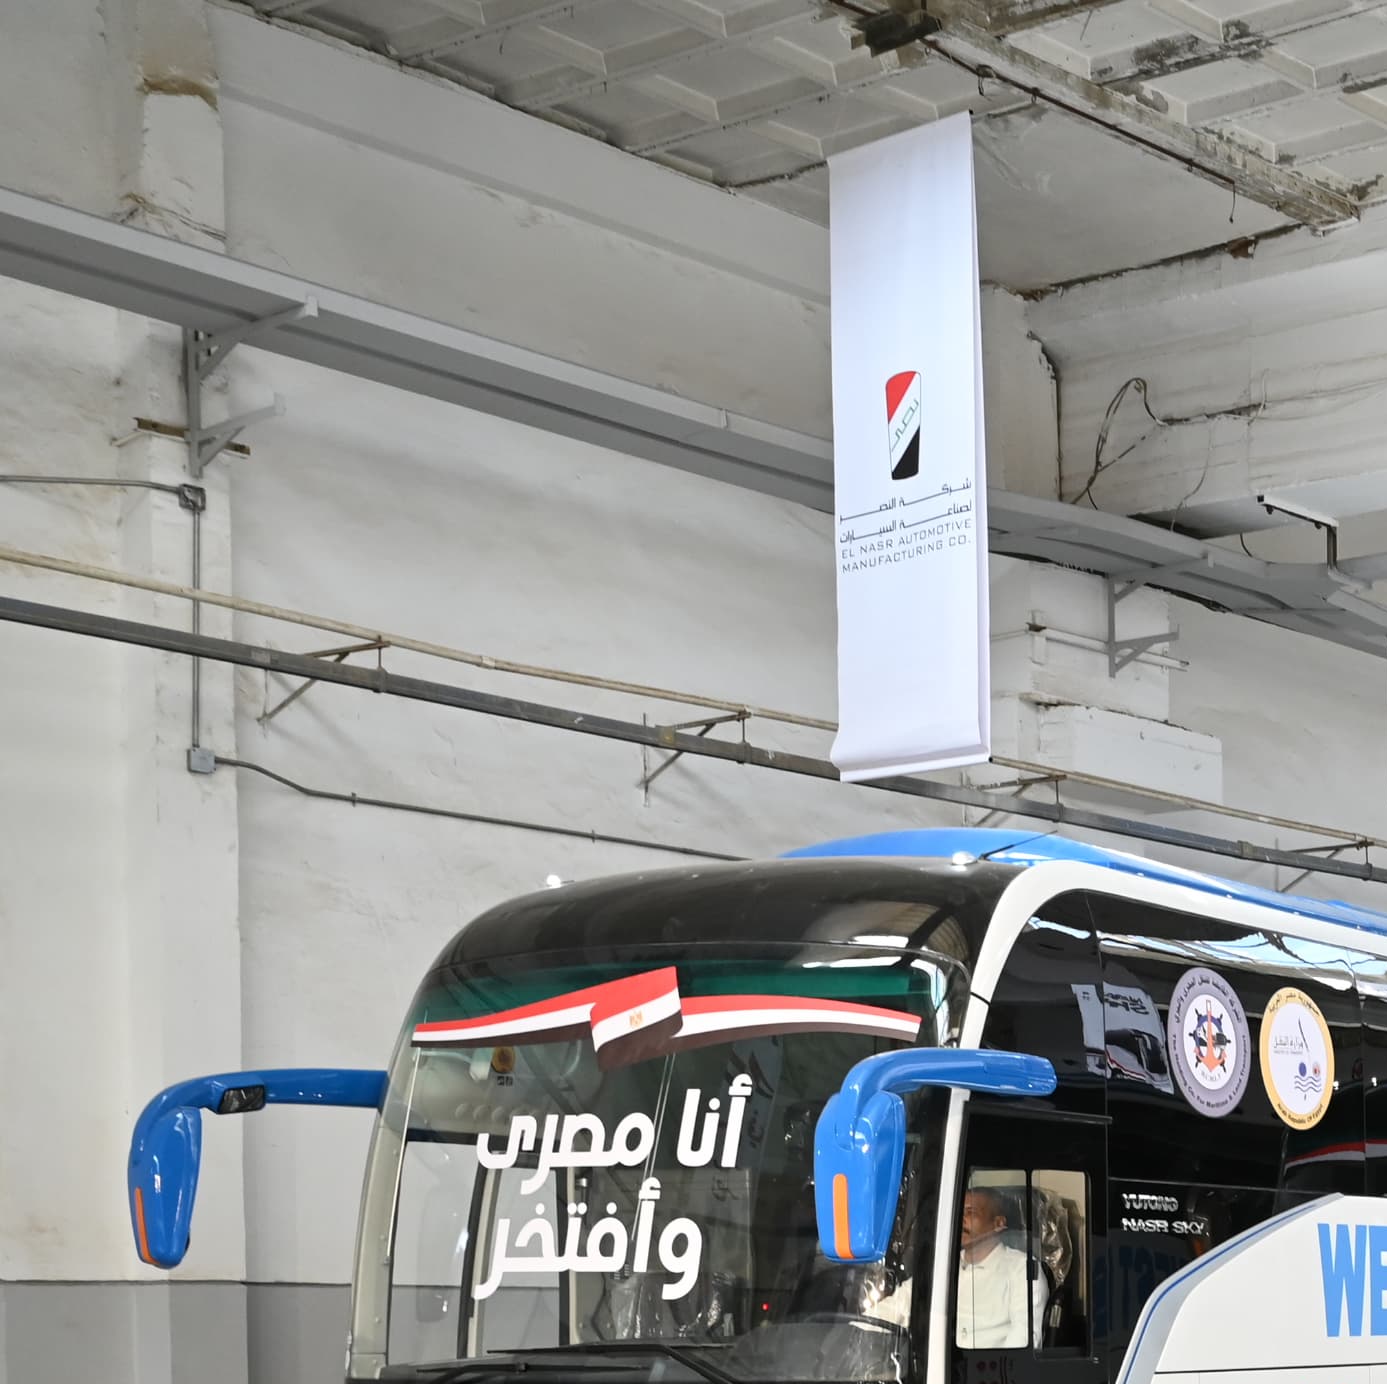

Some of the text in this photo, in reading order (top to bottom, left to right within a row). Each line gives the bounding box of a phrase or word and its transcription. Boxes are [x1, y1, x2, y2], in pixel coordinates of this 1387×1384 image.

[839, 477, 972, 525] شركة النصر
[839, 499, 972, 544] لصناعة السيارات
[841, 518, 972, 560] EL NASR AUTOMOTIVE
[842, 534, 972, 574] MANUFACTURING CO.
[476, 1072, 753, 1196] أنا مصرى
[472, 1177, 702, 1301] وأفتخر
[1121, 1217, 1205, 1235] NASR SKY
